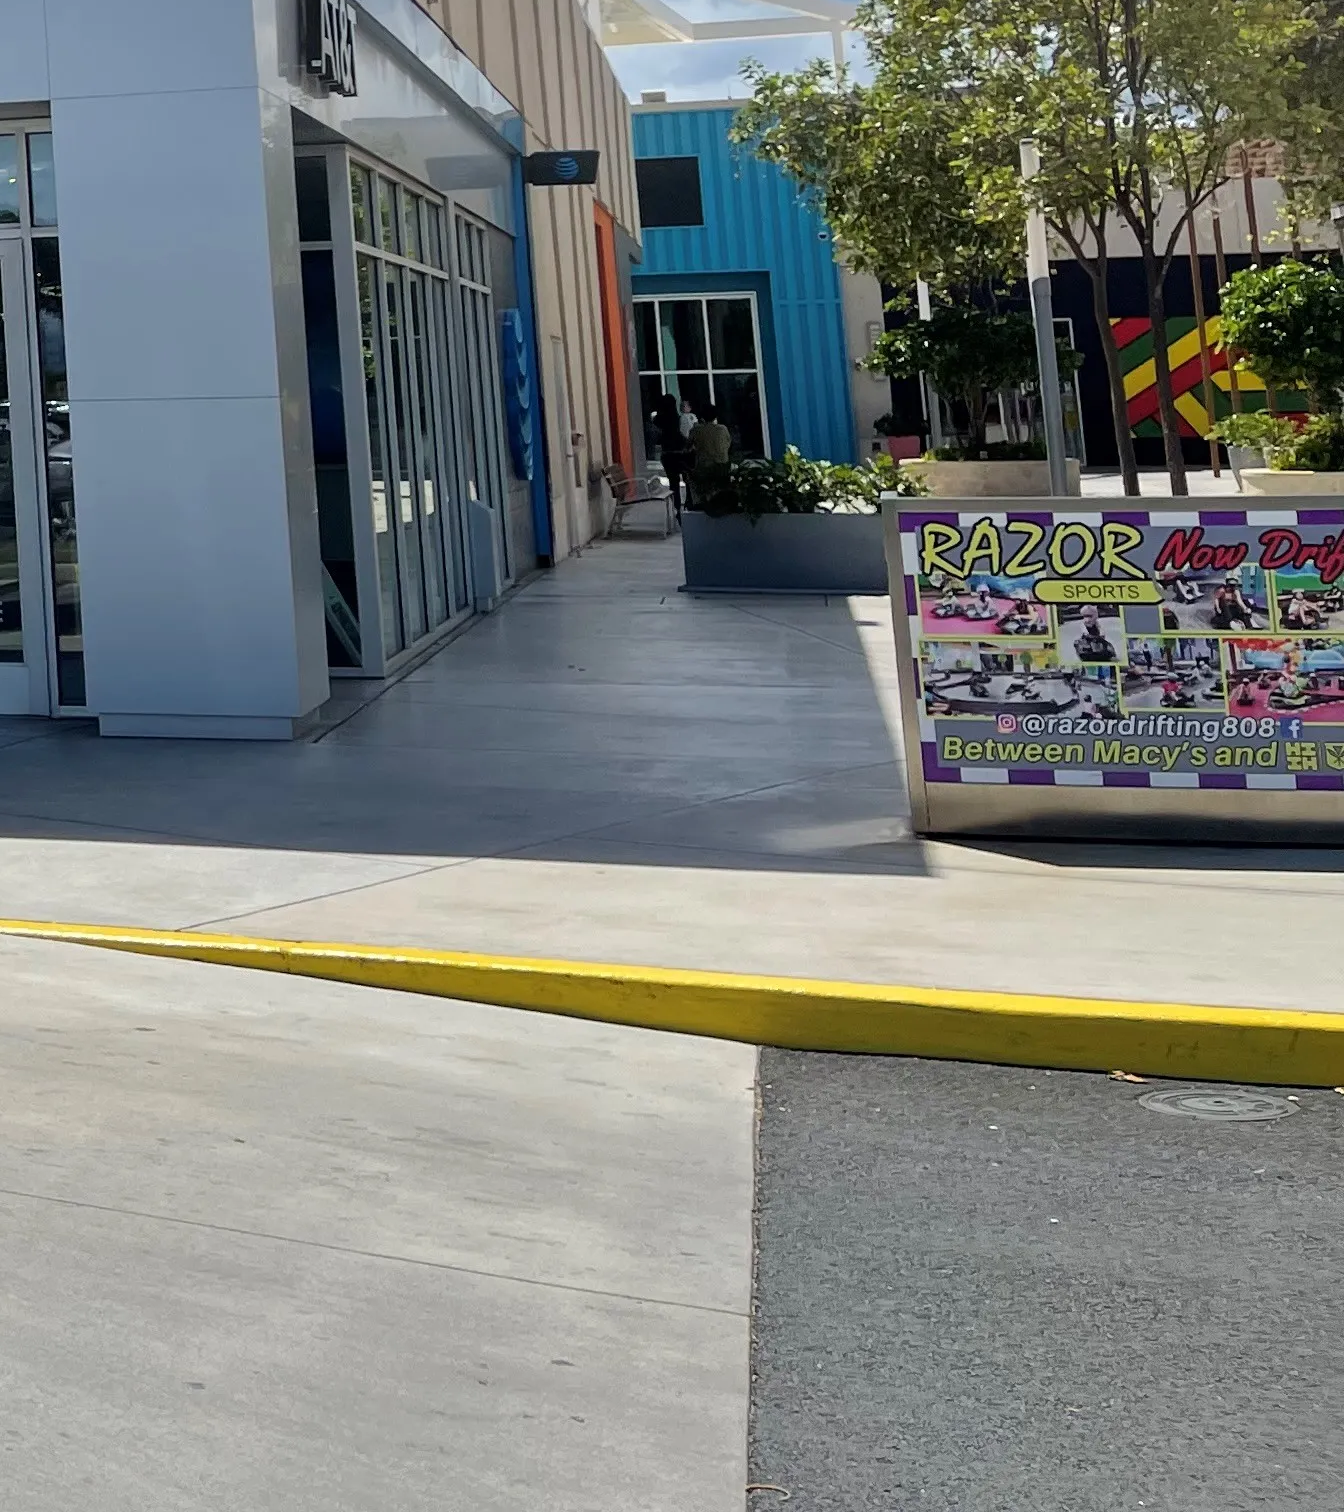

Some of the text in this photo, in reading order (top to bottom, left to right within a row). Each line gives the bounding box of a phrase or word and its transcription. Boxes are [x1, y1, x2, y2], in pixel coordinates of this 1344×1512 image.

[921, 518, 1146, 580] RAZOR
[1154, 527, 1249, 571] Now
[1063, 584, 1140, 600] SPORTS
[1022, 714, 1275, 742] @razordrifting808
[943, 737, 1279, 770] Between Macy's and
